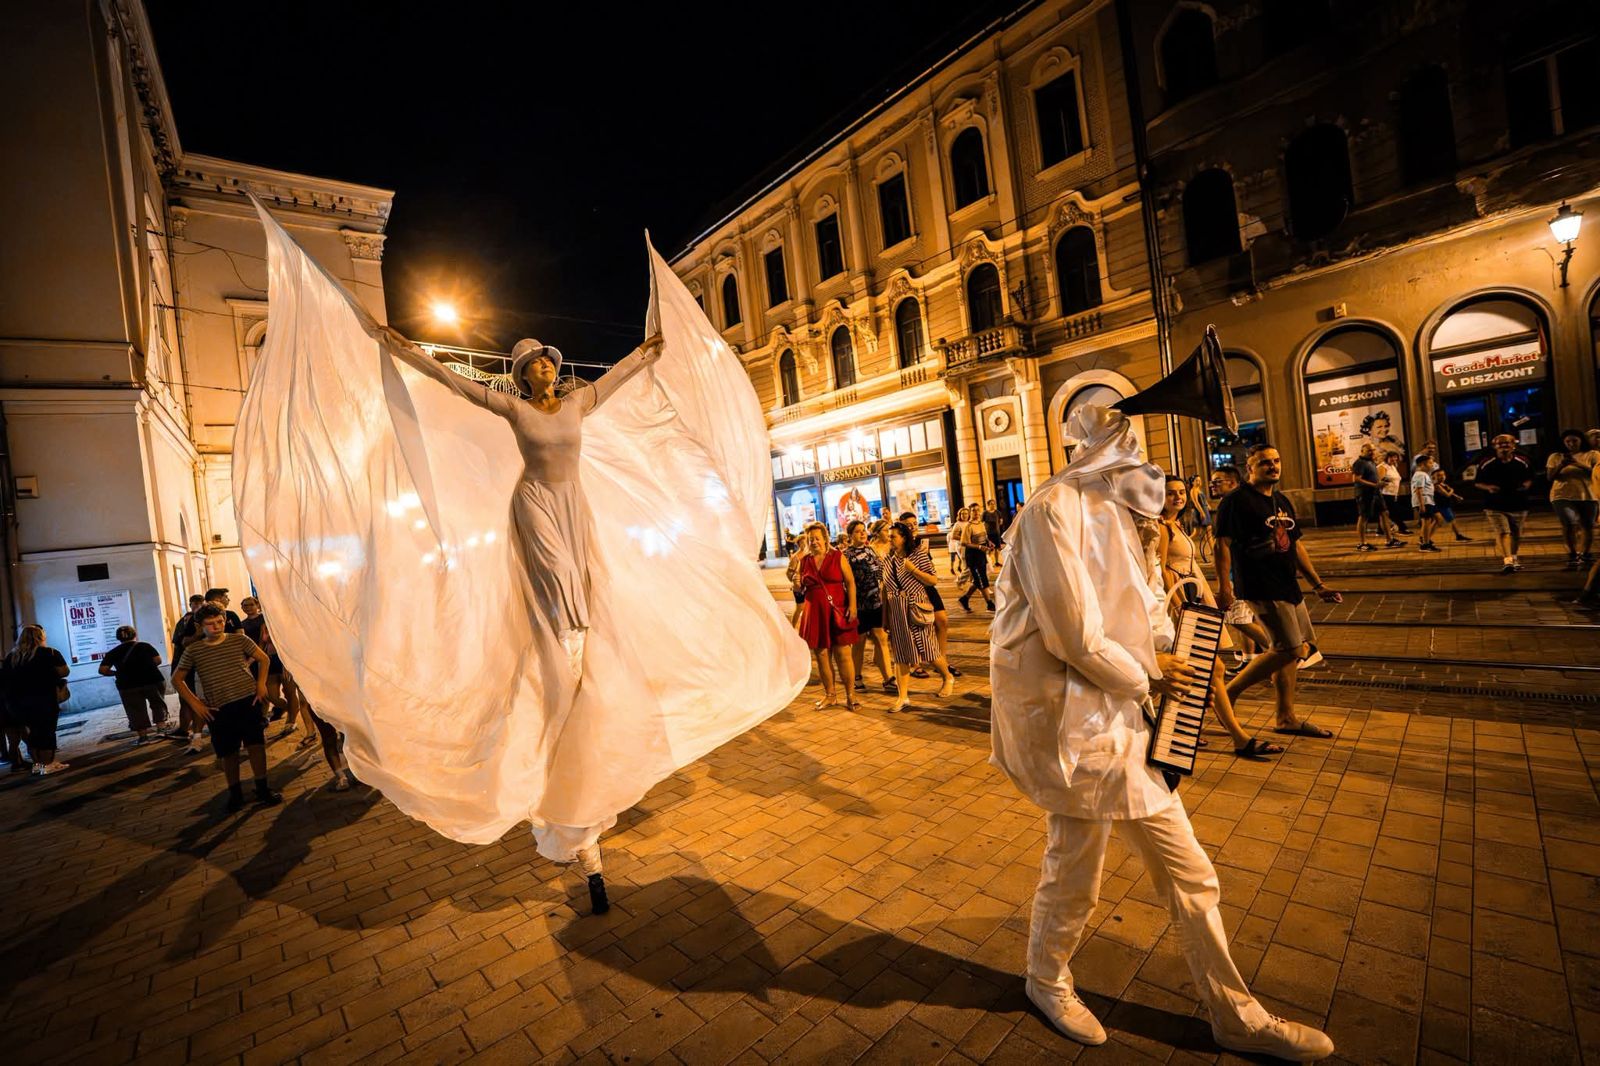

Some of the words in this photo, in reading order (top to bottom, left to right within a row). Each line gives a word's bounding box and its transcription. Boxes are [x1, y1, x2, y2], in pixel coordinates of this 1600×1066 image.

[1446, 379, 1457, 389] A
[1460, 366, 1535, 386] DISZKONT
[1319, 398, 1328, 407] A
[1330, 388, 1391, 406] DISZKONT
[823, 465, 872, 481] ROSSMANN
[86, 607, 96, 618] IS
